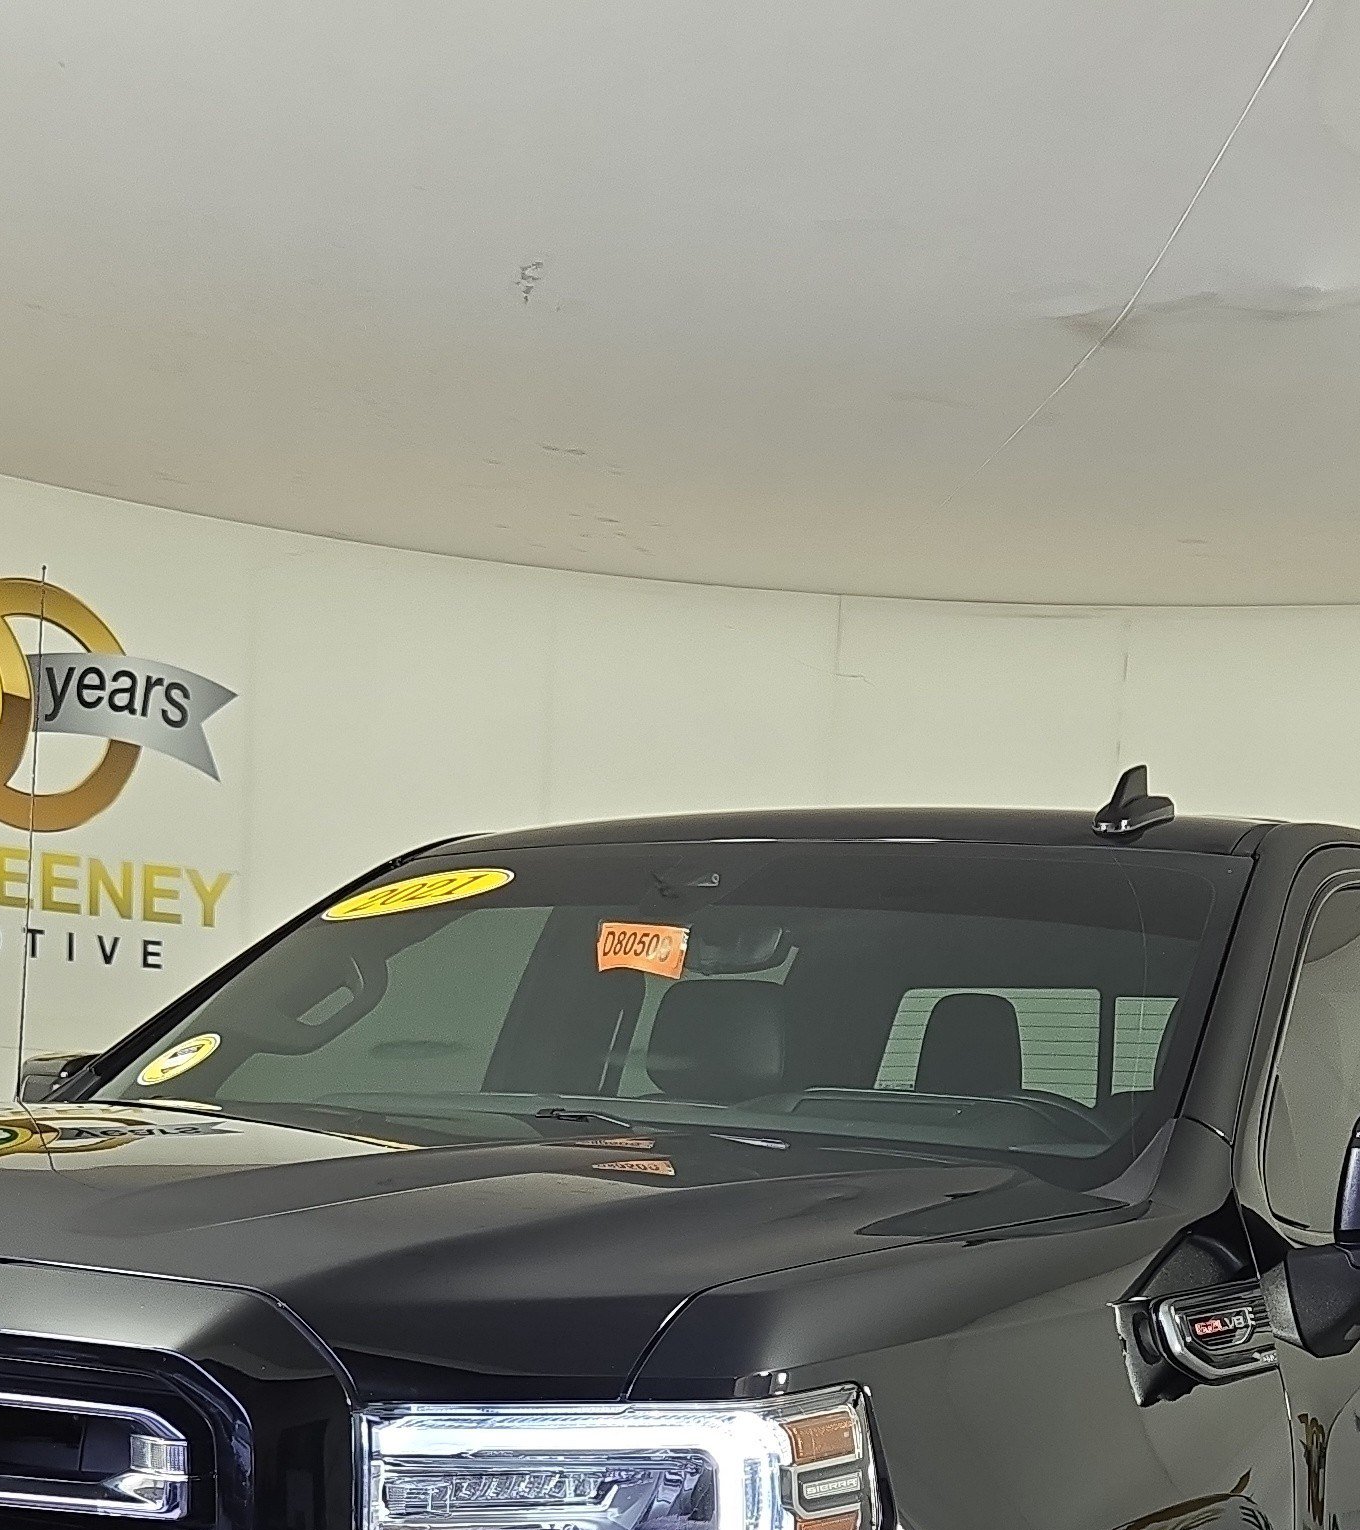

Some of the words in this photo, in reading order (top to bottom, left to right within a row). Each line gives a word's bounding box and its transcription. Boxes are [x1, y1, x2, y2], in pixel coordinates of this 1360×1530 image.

[43, 664, 192, 730] years
[343, 873, 490, 915] 2021
[806, 1477, 858, 1495] SIERRA
